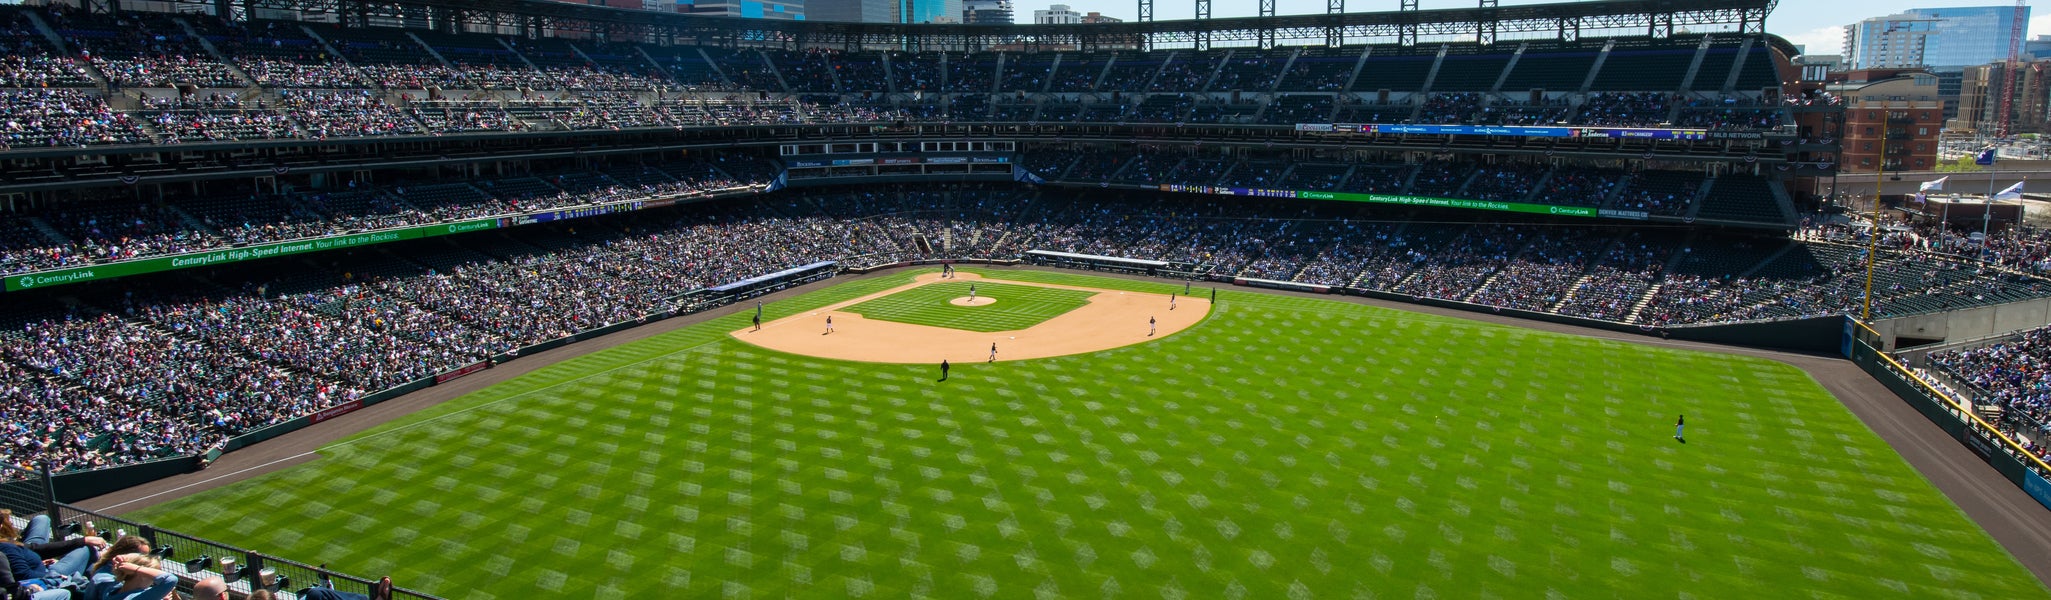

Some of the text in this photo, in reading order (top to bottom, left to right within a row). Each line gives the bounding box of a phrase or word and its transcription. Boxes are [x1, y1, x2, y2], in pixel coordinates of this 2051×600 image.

[1369, 194, 1398, 203] CenturyLink
[1398, 196, 1429, 204] High-Speed
[1558, 207, 1588, 216] CenturyLink
[457, 221, 489, 231] CenturyLink
[172, 252, 226, 268] CenturyLink
[228, 245, 279, 261] High-Speed
[316, 240, 333, 249] Your
[334, 237, 347, 246] link
[357, 235, 370, 244] the
[37, 270, 94, 284] CenturyLink
[323, 407, 344, 418] Benjamin
